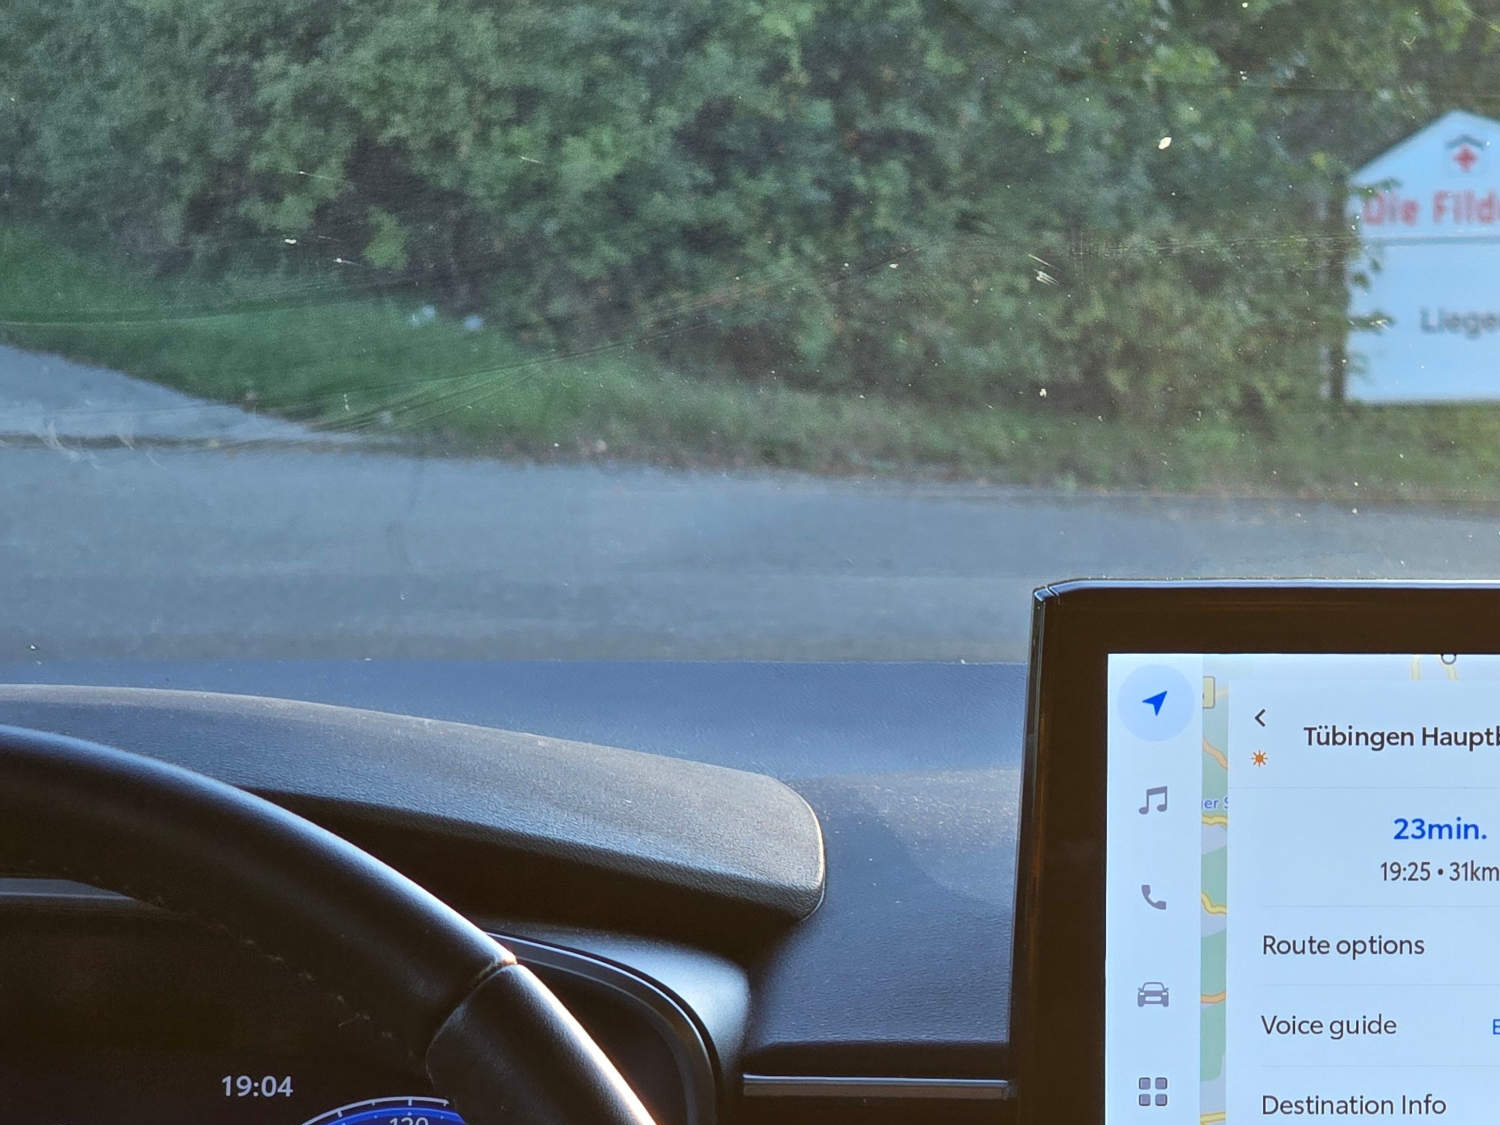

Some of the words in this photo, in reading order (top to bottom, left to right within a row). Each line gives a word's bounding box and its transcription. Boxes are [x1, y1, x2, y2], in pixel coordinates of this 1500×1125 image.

[1363, 192, 1417, 225] Die
[1304, 726, 1415, 751] Tübingen
[1393, 817, 1488, 841] 23min.
[1380, 861, 1431, 882] 19:25
[1449, 861, 1500, 882] 31km
[1263, 936, 1331, 955] Route
[1336, 935, 1425, 960] options
[1261, 1015, 1323, 1036] Voice
[1330, 1014, 1397, 1039] guide
[221, 1076, 293, 1097] 19:04
[1262, 1095, 1394, 1116] Destination
[1402, 1095, 1447, 1116] Info
